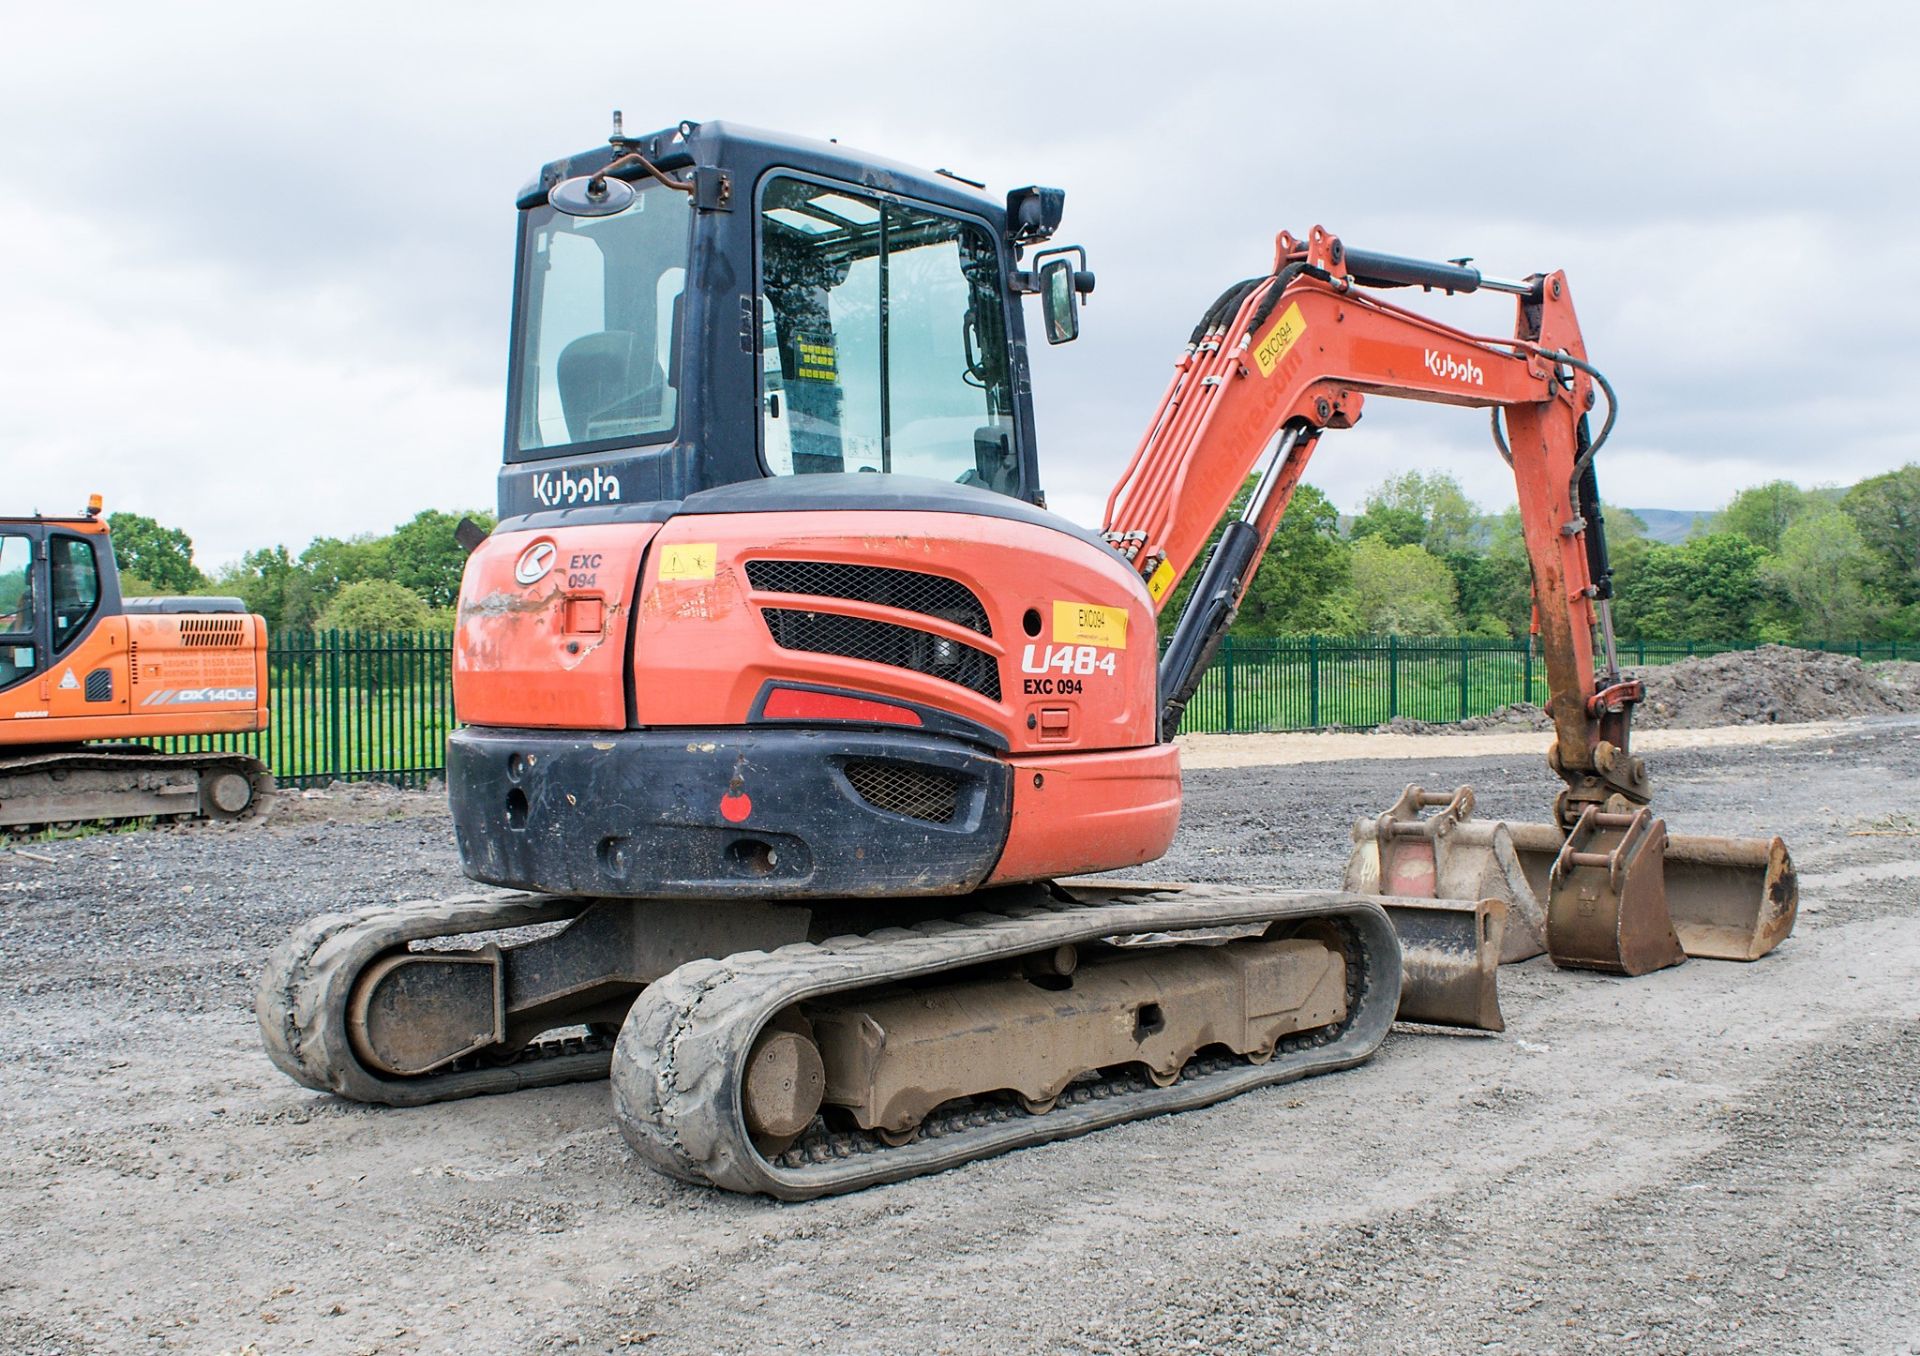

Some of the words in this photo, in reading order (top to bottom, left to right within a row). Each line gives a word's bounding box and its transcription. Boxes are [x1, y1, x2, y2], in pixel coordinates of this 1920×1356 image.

[1260, 321, 1292, 366] EXC094
[1424, 349, 1484, 386] Kubota
[533, 467, 620, 506] Kubota
[570, 554, 603, 570] EXC
[568, 573, 596, 589] 094
[1024, 679, 1053, 695] EXC
[1057, 679, 1083, 694] 094
